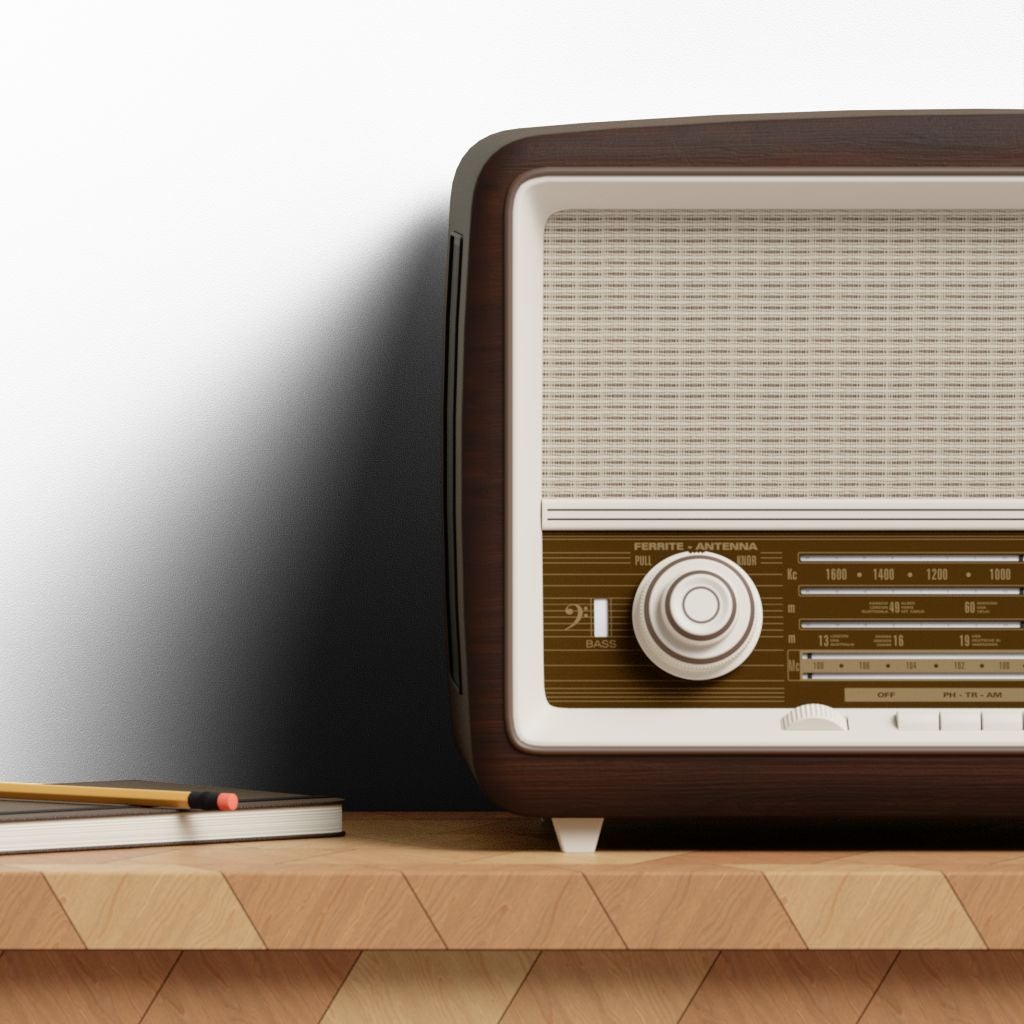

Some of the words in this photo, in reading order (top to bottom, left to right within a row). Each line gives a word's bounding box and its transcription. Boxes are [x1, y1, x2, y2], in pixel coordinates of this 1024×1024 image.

[633, 541, 684, 551] FERRITE
[695, 541, 758, 551] ANTENNA
[634, 555, 652, 567] PULL
[825, 567, 848, 581] 1600
[873, 567, 895, 581] 1400
[926, 567, 949, 581] 1200
[989, 567, 1012, 581] 1000
[888, 601, 900, 614] 49
[964, 601, 976, 614] 60
[585, 639, 617, 649] BASS
[818, 634, 829, 647] 13
[893, 634, 904, 647] 16
[959, 634, 970, 647] 19
